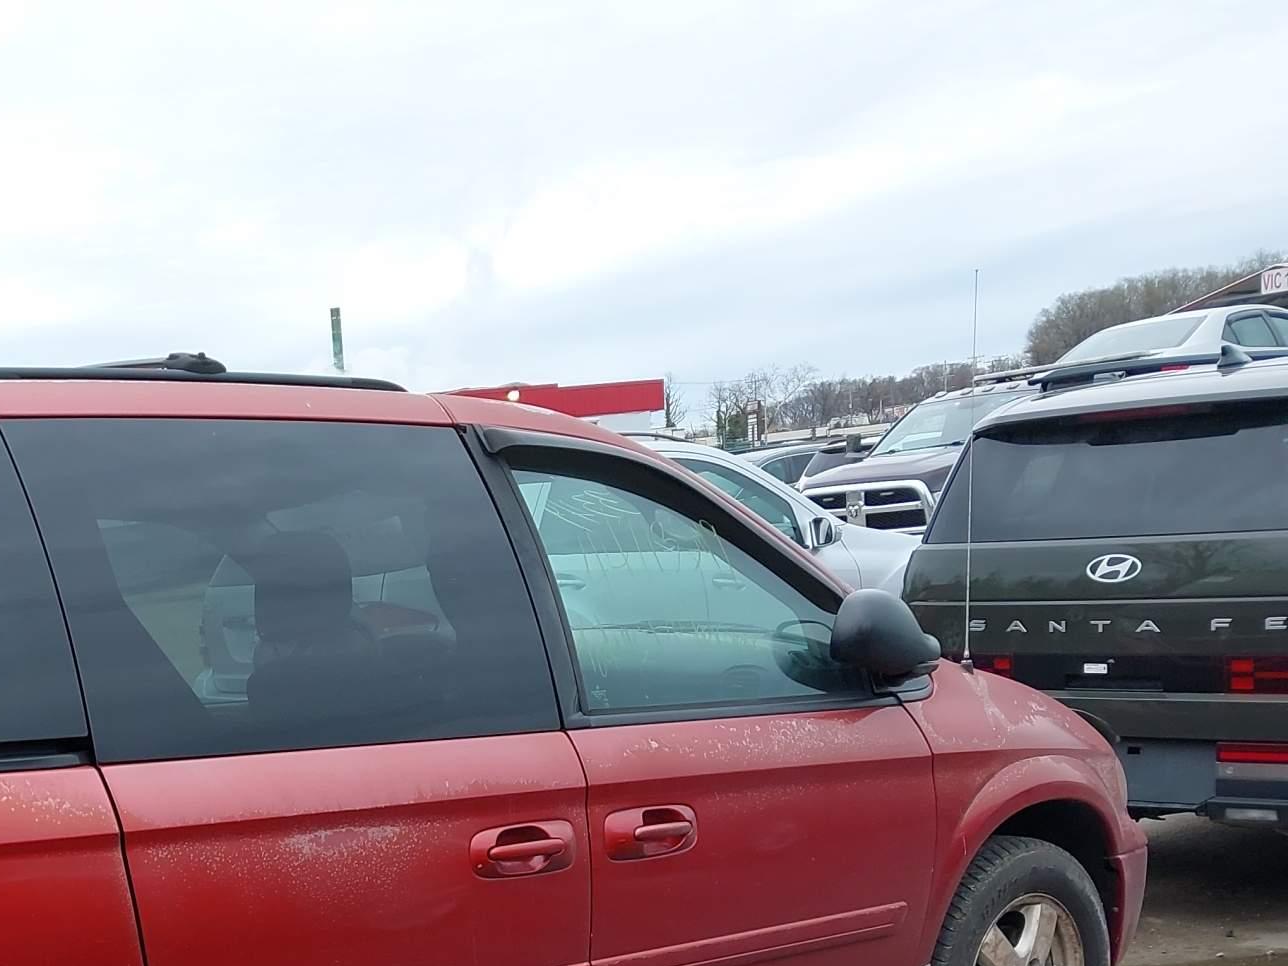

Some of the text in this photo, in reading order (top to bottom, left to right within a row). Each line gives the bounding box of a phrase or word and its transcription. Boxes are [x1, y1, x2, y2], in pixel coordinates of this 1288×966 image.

[1262, 272, 1282, 290] VIC
[968, 616, 1288, 633] SANTA FE
